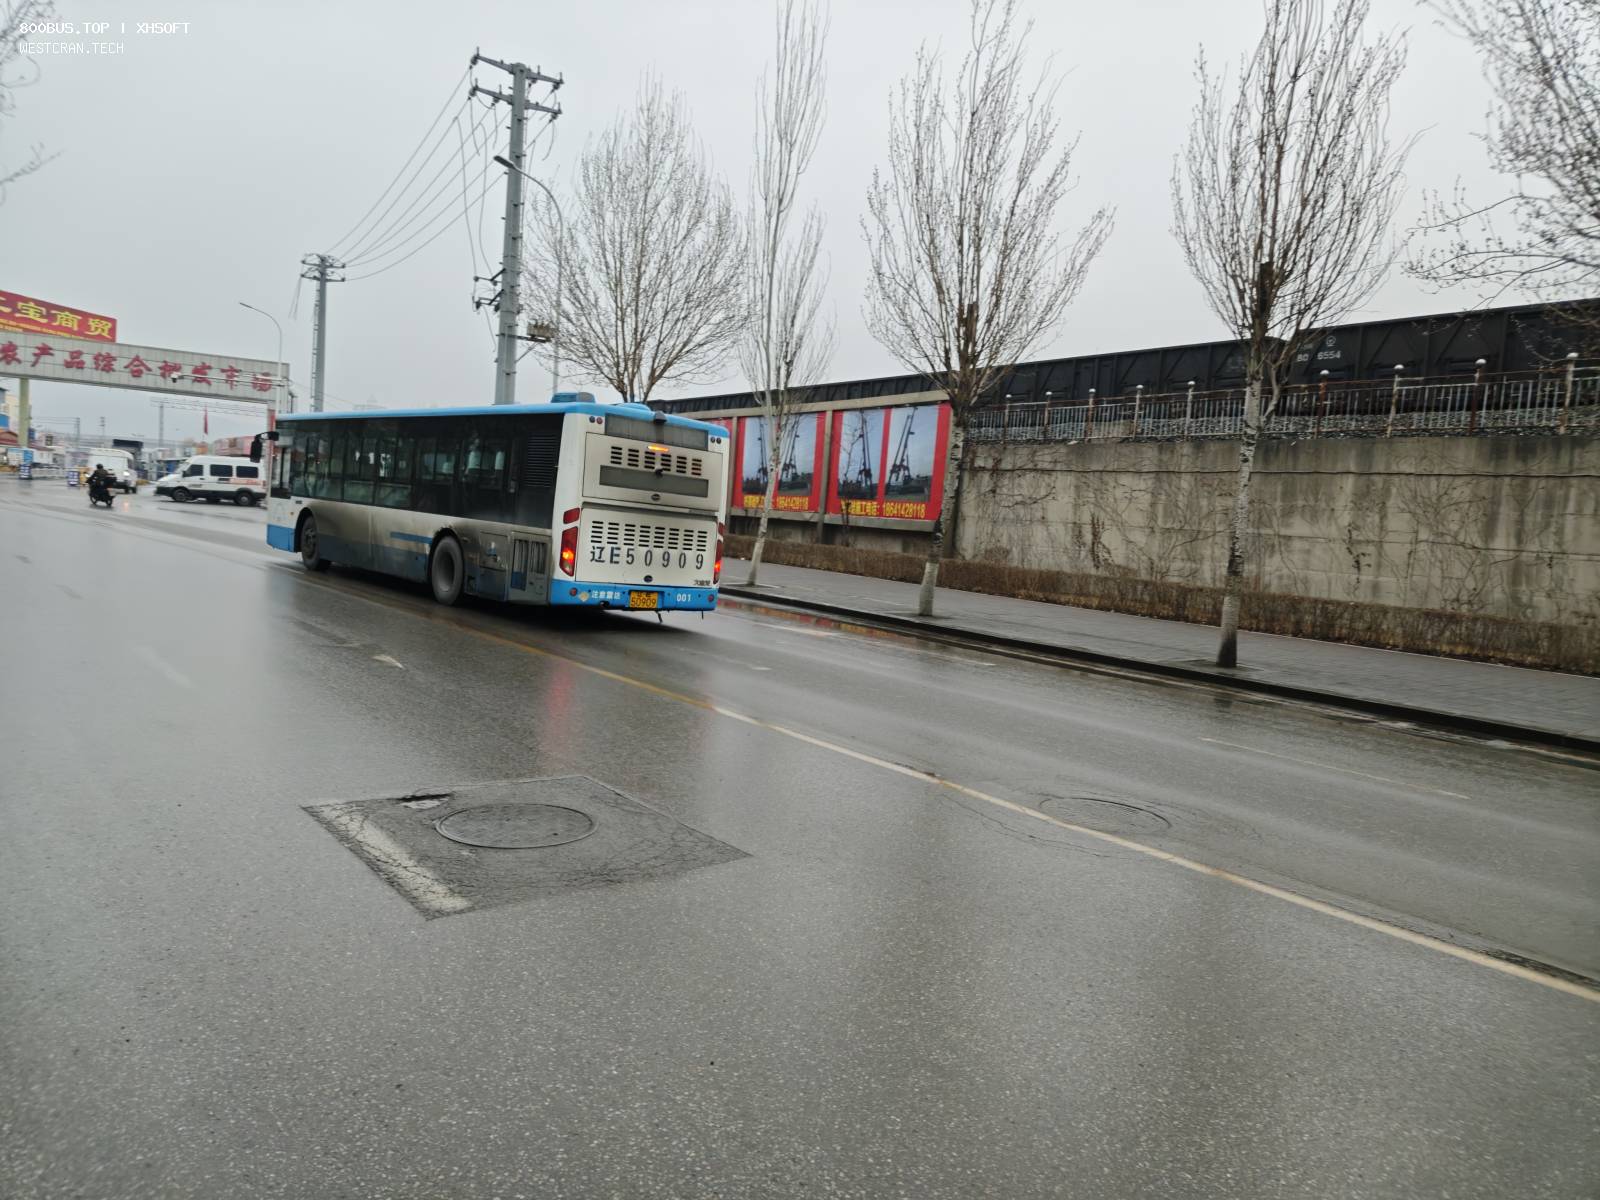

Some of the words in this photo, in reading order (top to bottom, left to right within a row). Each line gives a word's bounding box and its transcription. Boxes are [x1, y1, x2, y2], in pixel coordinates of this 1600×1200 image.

[590, 545, 704, 570] 辽E50909
[630, 597, 657, 608] 50909
[676, 593, 692, 602] 001
